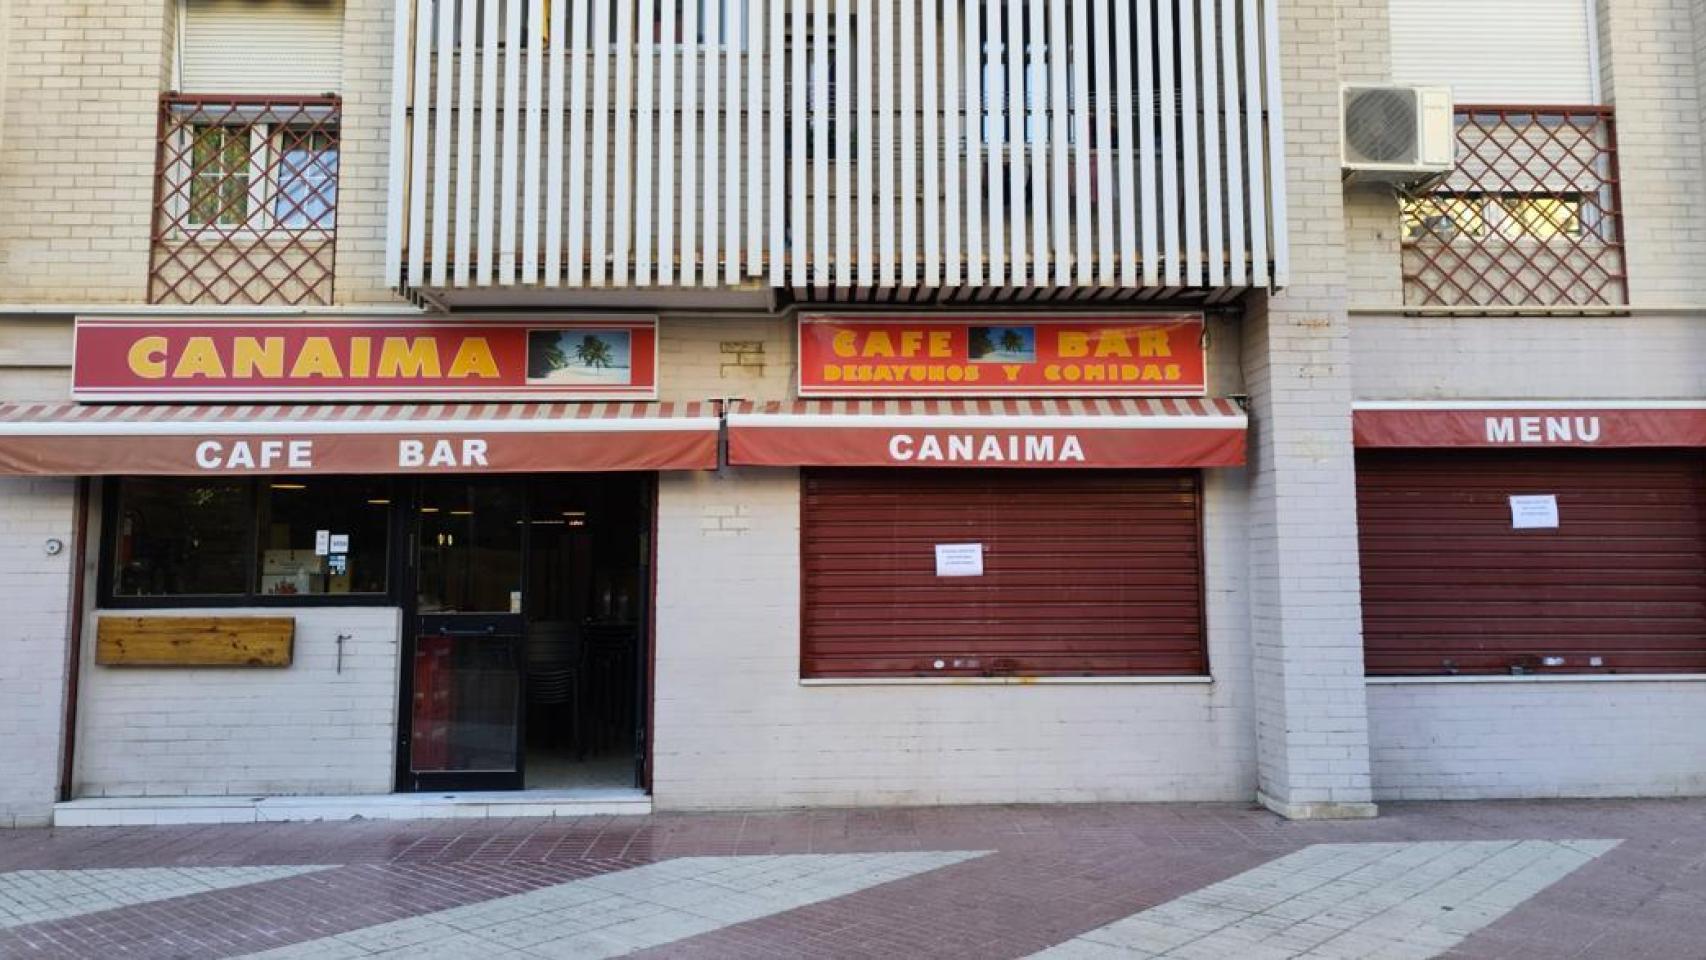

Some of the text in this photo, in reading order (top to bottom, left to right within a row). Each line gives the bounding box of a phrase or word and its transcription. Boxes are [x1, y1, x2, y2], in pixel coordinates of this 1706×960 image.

[128, 336, 500, 378] CANAIMA
[831, 329, 1172, 359] CAFE BAR
[823, 364, 1181, 382] DESAYUNOS Y COMIDAS
[1484, 416, 1601, 443] MENU
[195, 438, 489, 470] CAFE BAR
[888, 434, 1086, 462] CANAIMA
